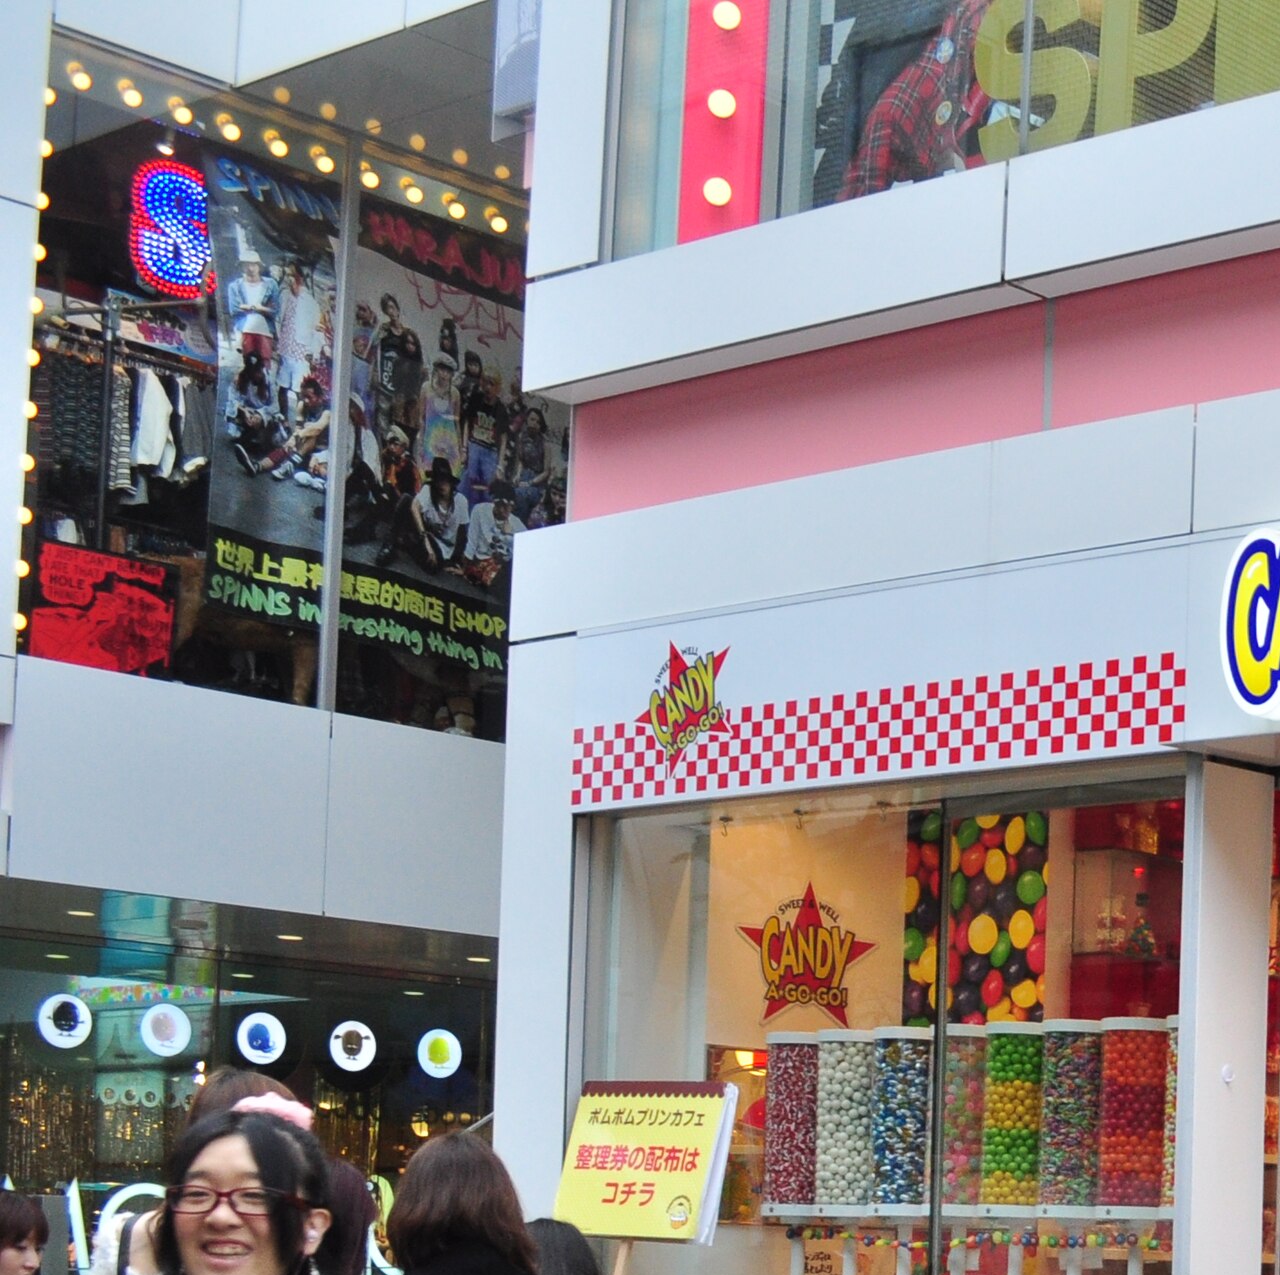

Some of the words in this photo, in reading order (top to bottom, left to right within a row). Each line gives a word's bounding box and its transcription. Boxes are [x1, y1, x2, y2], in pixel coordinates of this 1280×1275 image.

[209, 574, 293, 616] SPINNS
[298, 597, 424, 656] ineresting
[649, 651, 715, 748] CANDY
[761, 915, 856, 990] CANDY
[574, 1144, 701, 1173] 整理券の配布は
[601, 1181, 656, 1207] コチラ
